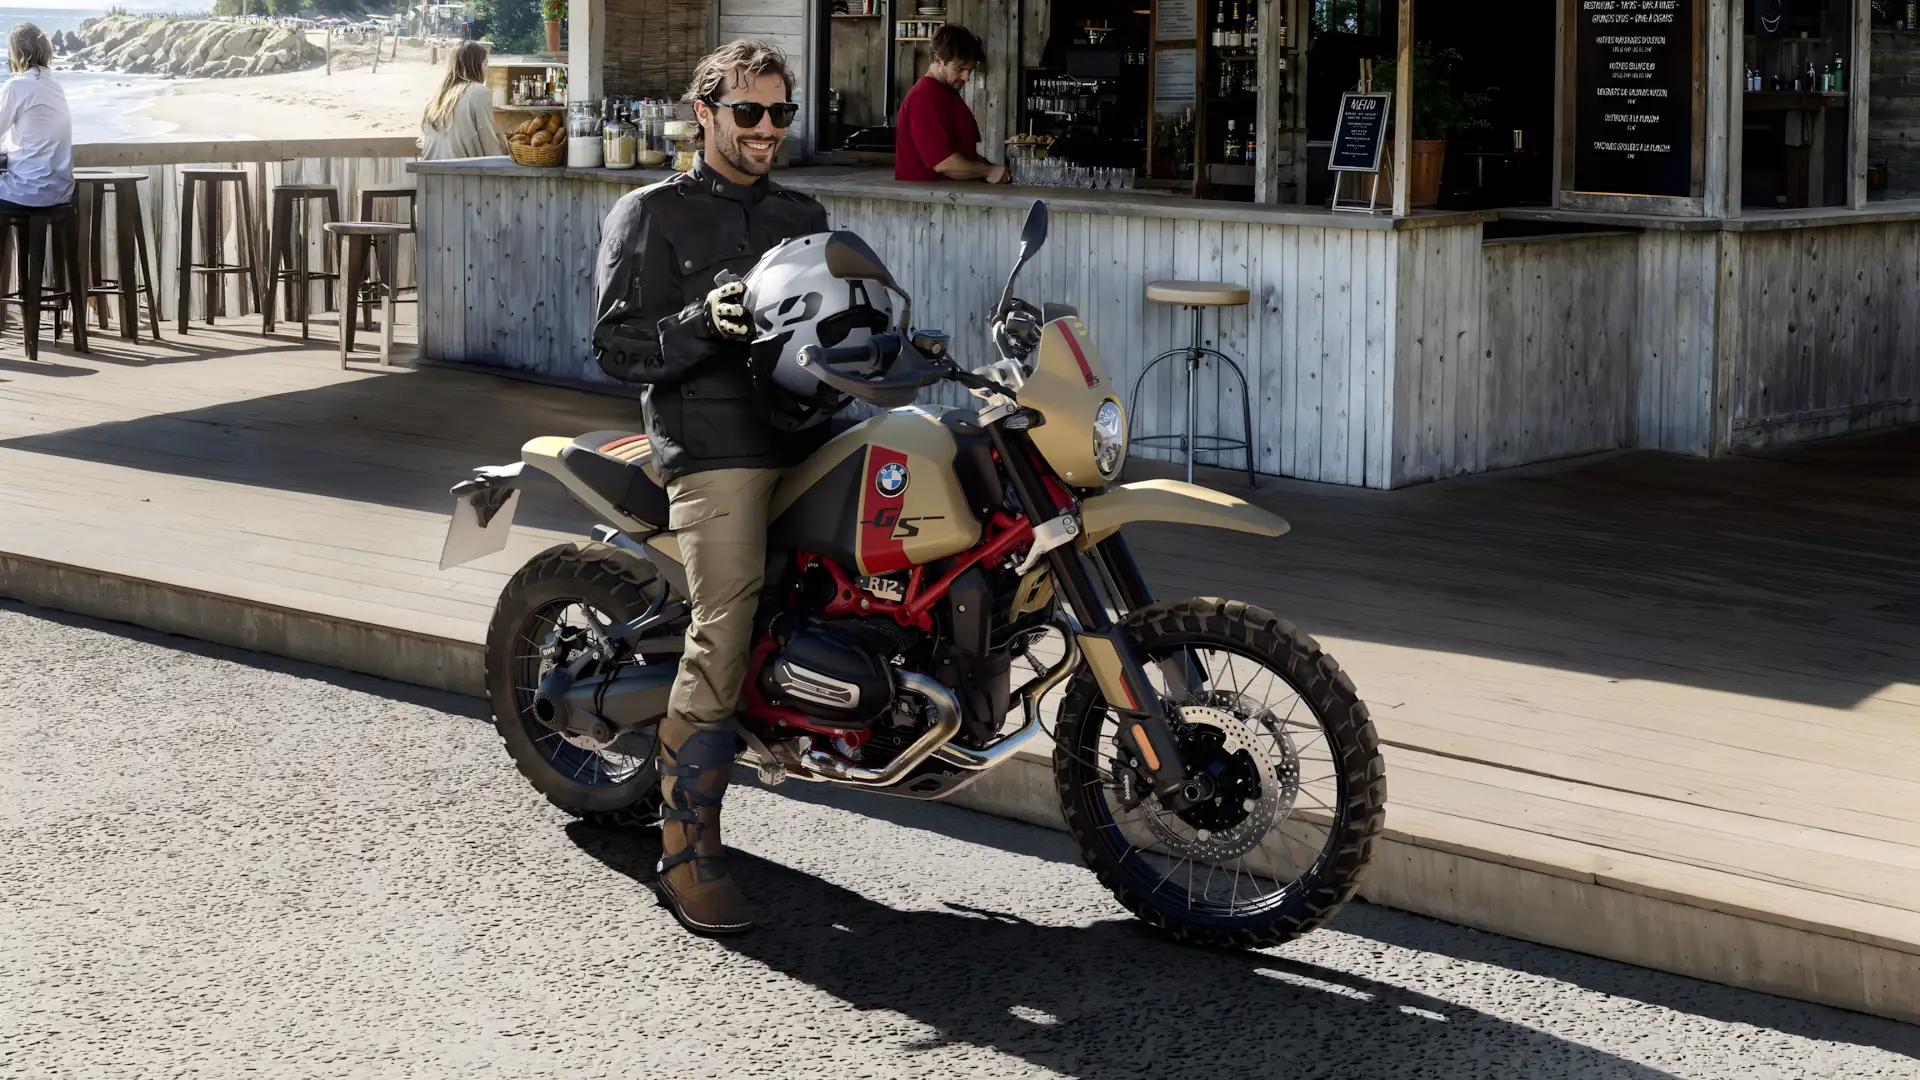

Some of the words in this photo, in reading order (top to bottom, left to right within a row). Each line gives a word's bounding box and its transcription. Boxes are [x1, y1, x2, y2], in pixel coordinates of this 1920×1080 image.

[1350, 98, 1377, 111] MENU
[871, 507, 923, 538] GS
[868, 576, 899, 593] R12
